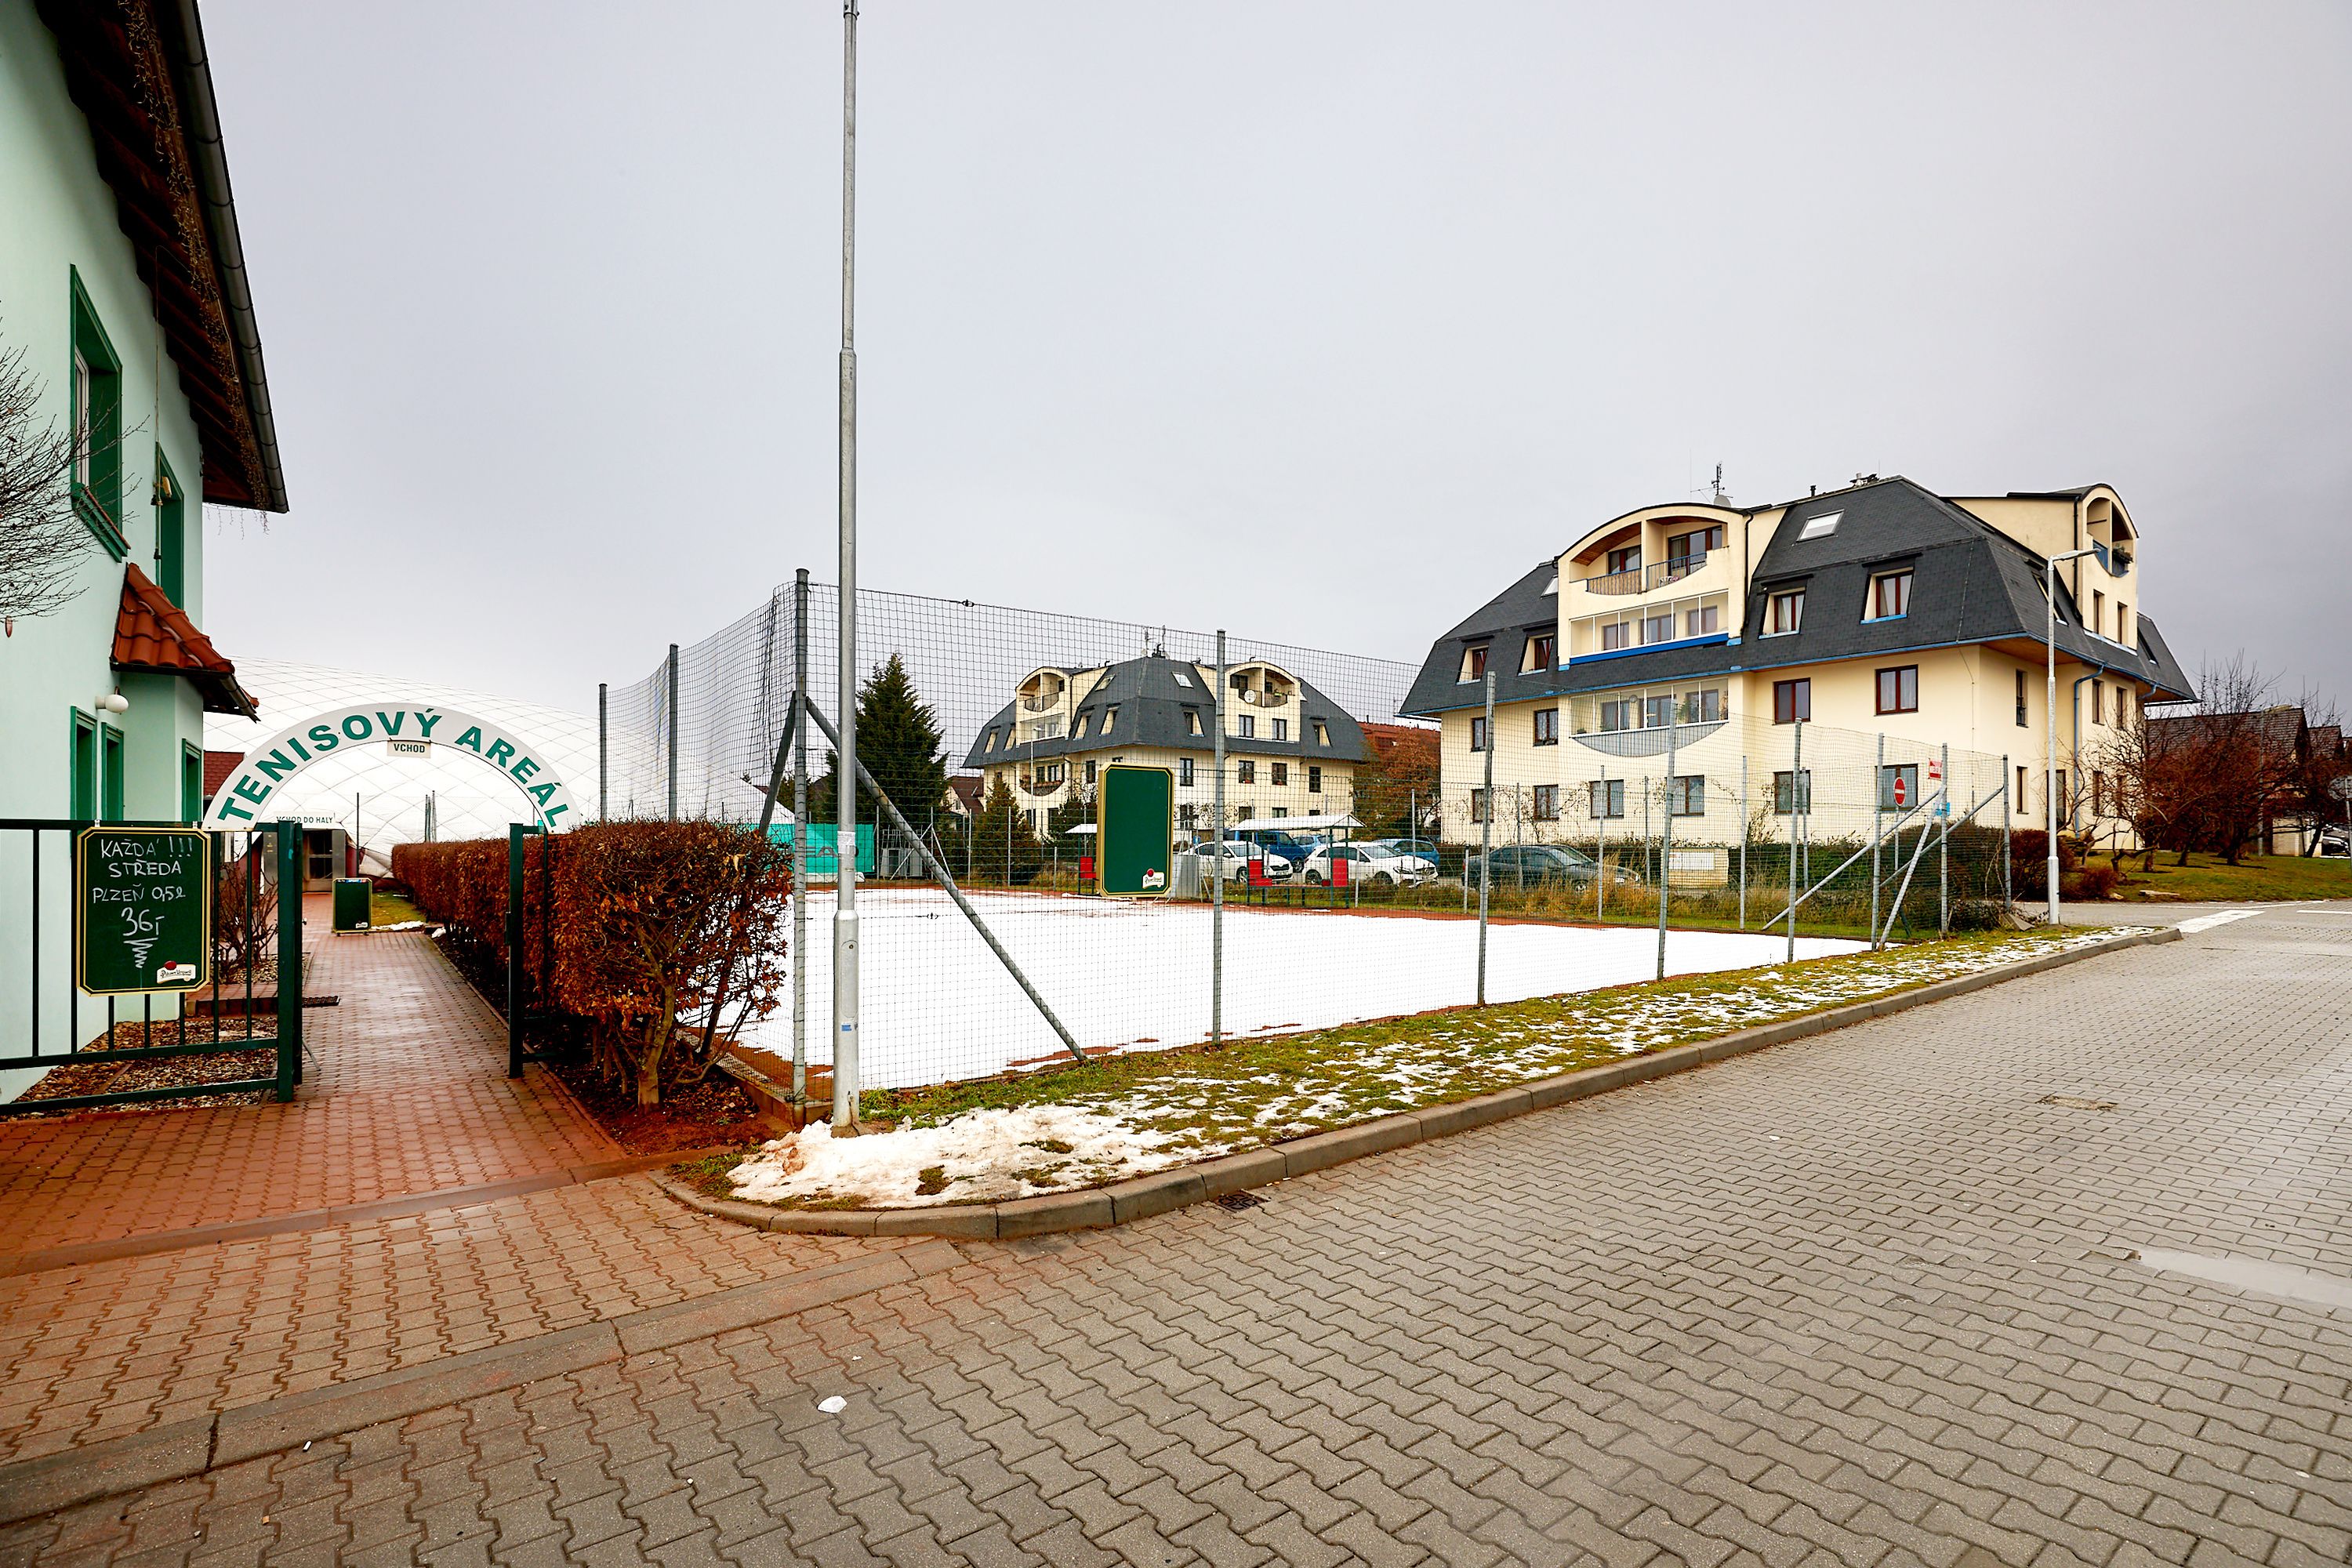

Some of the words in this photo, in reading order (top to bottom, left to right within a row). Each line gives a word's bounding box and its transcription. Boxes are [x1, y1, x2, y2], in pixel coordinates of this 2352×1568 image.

[394, 743, 426, 753] VCHOD
[216, 708, 443, 821] TENISOVÝ
[454, 725, 569, 828] AREÁL
[100, 837, 160, 858] KAŽDÁ
[108, 858, 182, 877] STŘEDA
[93, 883, 145, 903] PLZEŇ
